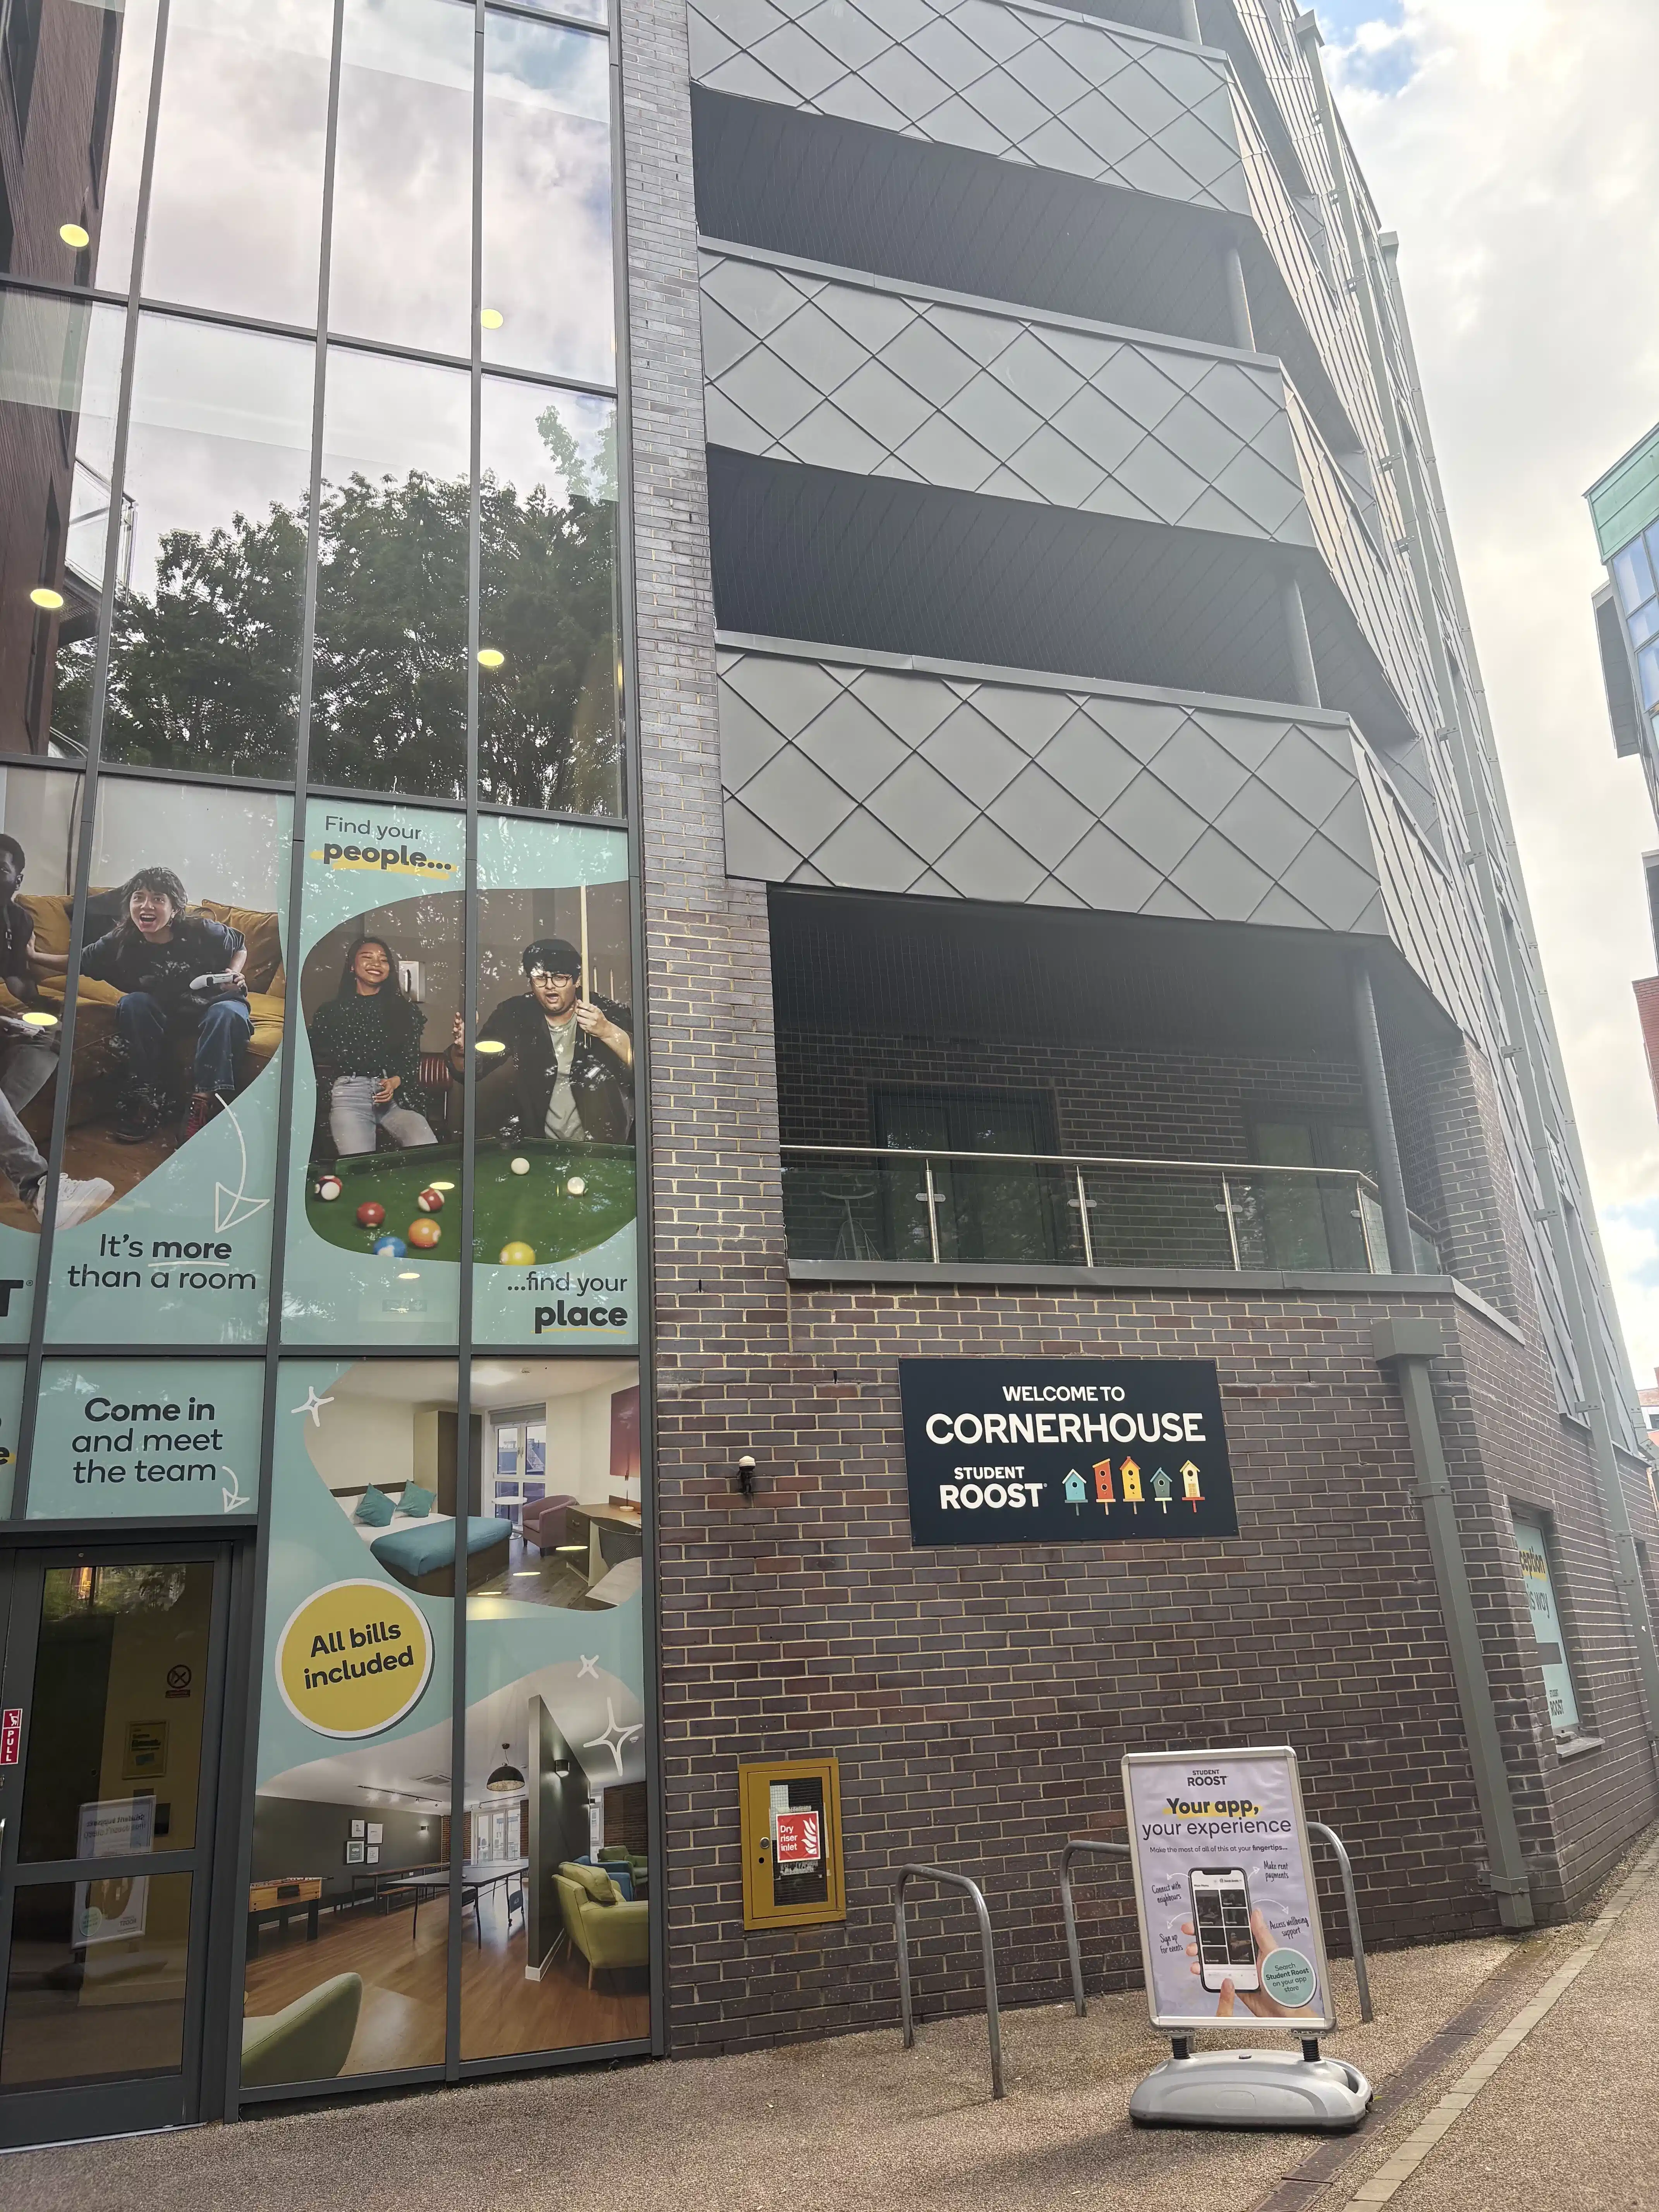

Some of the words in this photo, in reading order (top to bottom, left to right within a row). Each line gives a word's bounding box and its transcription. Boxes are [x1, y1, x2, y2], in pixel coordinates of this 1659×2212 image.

[325, 816, 370, 835] Find
[377, 825, 422, 840] your
[323, 843, 452, 870] people...
[100, 1234, 143, 1257] It's
[153, 1242, 232, 1259] more
[68, 1265, 141, 1288] than
[151, 1272, 168, 1288] a
[180, 1272, 256, 1289] room
[508, 1271, 569, 1291] ...find
[577, 1278, 627, 1297] your
[535, 1300, 628, 1333] place
[1002, 1386, 1099, 1401] WELCOME
[1100, 1386, 1125, 1401] TO
[85, 1398, 180, 1422] Come
[189, 1398, 215, 1420] in
[926, 1413, 1206, 1444] CORNERHOUSE
[72, 1428, 133, 1453] and
[144, 1429, 223, 1451] meet
[73, 1460, 125, 1484] the
[135, 1462, 216, 1482] team
[954, 1466, 1025, 1480] STUDENT
[1519, 1546, 1546, 1579] ception
[1534, 1592, 1550, 1619] way
[311, 1631, 345, 1657] All
[350, 1621, 401, 1648] bills
[304, 1645, 414, 1689] included
[1550, 1699, 1564, 1716] ROOST
[6, 1730, 14, 1762] PULL
[1187, 1776, 1227, 1786] ROOST
[1166, 1798, 1210, 1814] Your
[1215, 1800, 1259, 1817] app,
[780, 1825, 794, 1834] Dry
[780, 1834, 798, 1842] riser
[1142, 1824, 1182, 1841] your
[1187, 1817, 1291, 1838] experience
[781, 1843, 797, 1851] inlet
[1264, 1860, 1277, 1870] Make
[1265, 1871, 1289, 1882] payments
[1152, 1884, 1170, 1894] Connect
[1171, 1881, 1181, 1890] with
[1157, 1893, 1182, 1906] neighbours
[1269, 1921, 1286, 1929] Access
[1287, 1916, 1309, 1927] wellbeing
[1159, 1934, 1171, 1946] Sign
[1172, 1934, 1178, 1944] up
[1282, 1927, 1301, 1939] support
[1169, 1944, 1183, 1952] events
[1266, 1971, 1290, 1980] Student
[1275, 1963, 1296, 1971] Search
